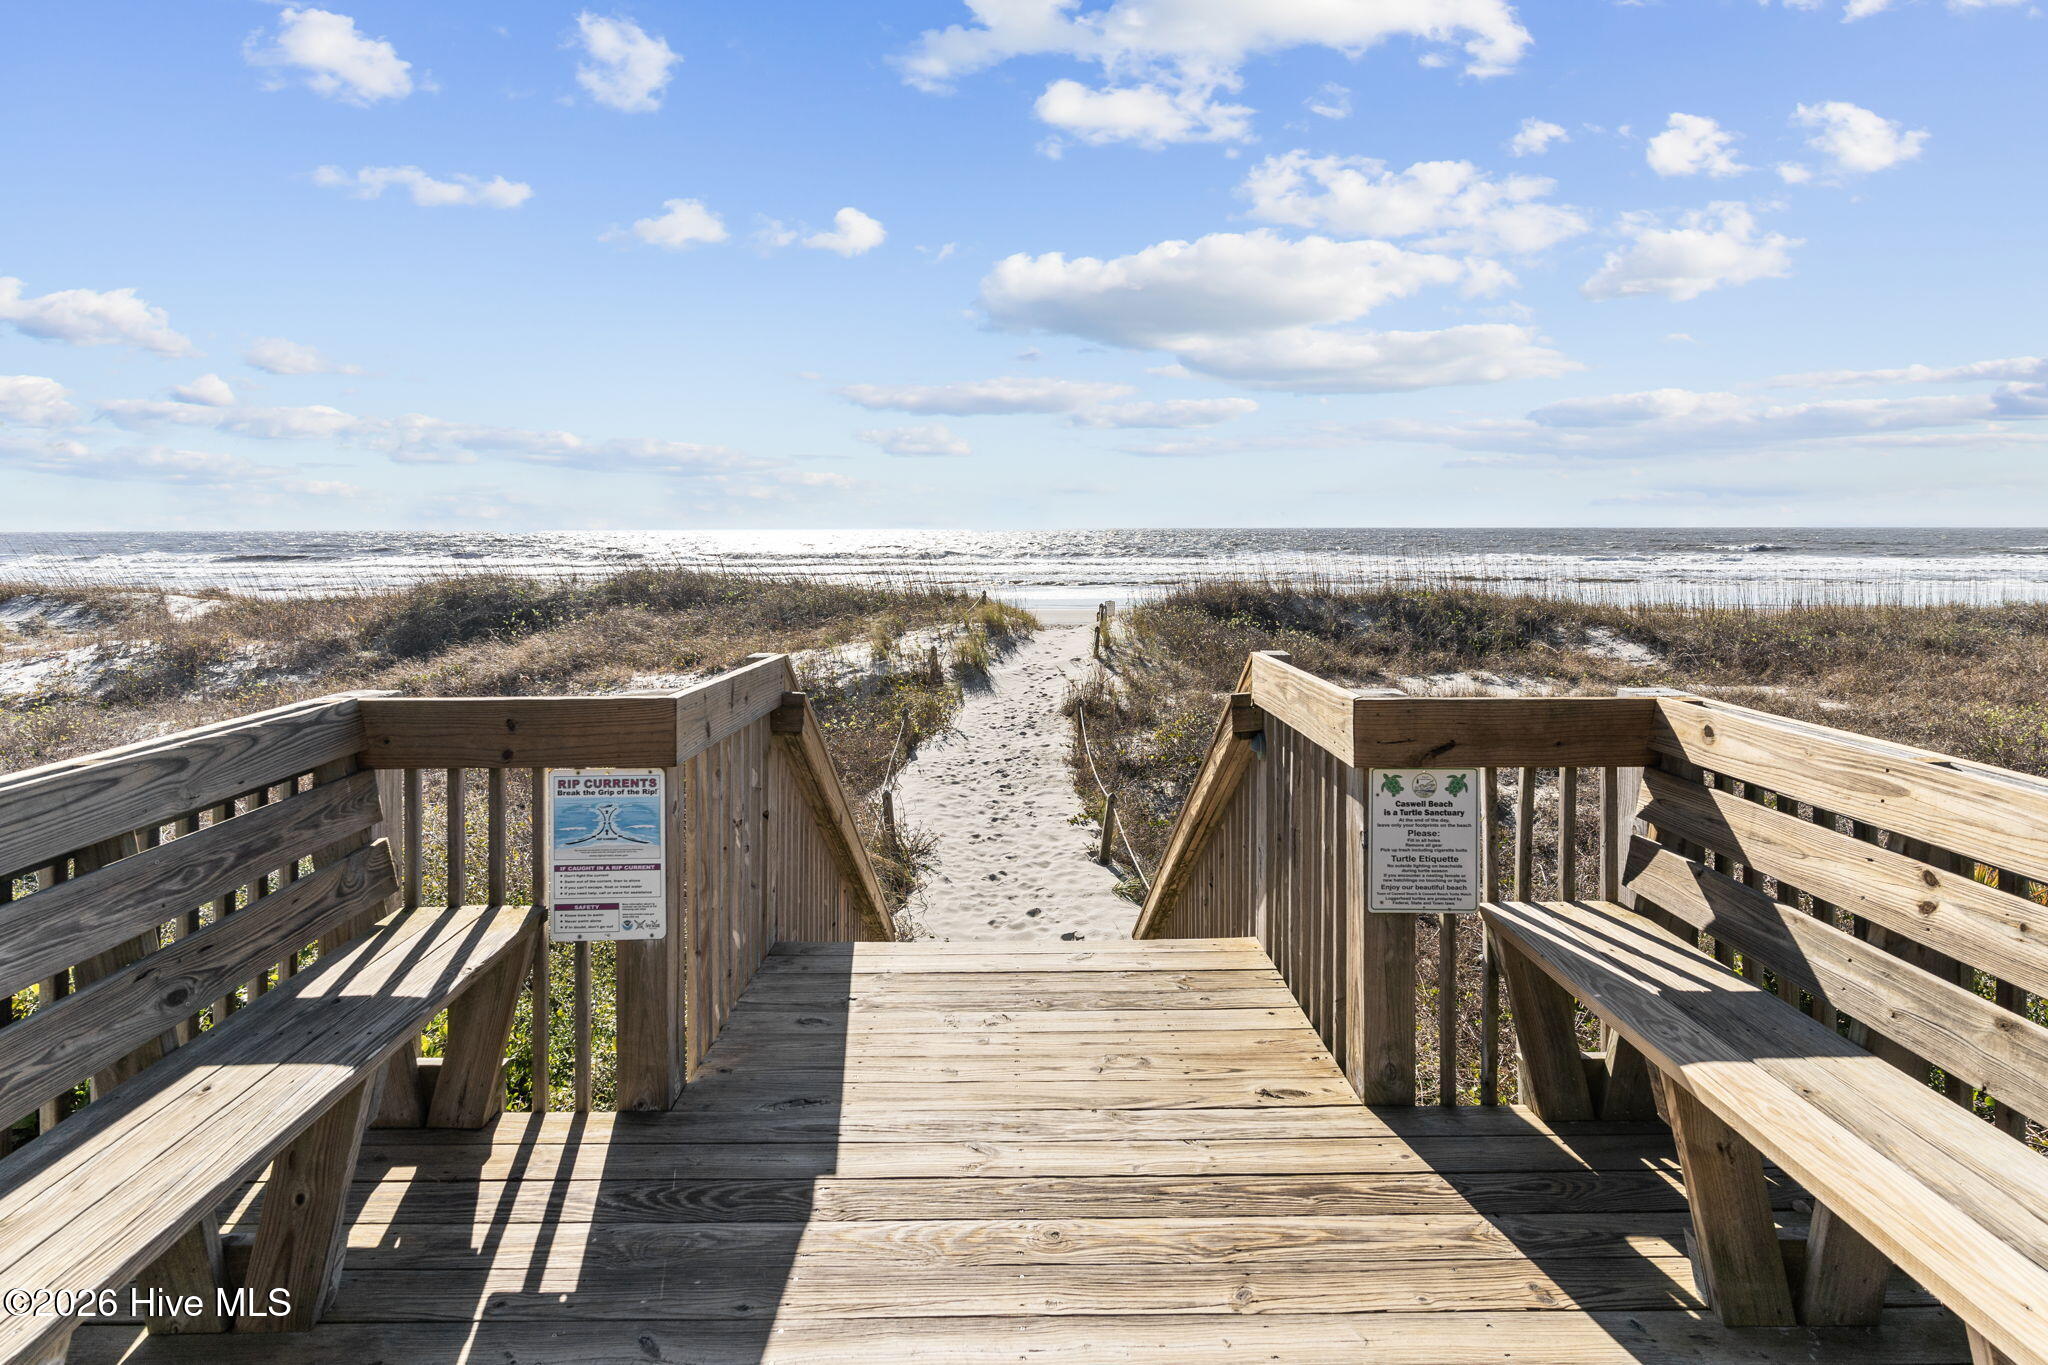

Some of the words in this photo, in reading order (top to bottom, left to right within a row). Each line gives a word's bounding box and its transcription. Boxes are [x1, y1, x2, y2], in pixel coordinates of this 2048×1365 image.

[558, 779, 580, 788] RIP
[584, 778, 657, 788] CURRENTS
[1424, 809, 1464, 817] Sanctuary
[1419, 855, 1459, 863] Etiquette
